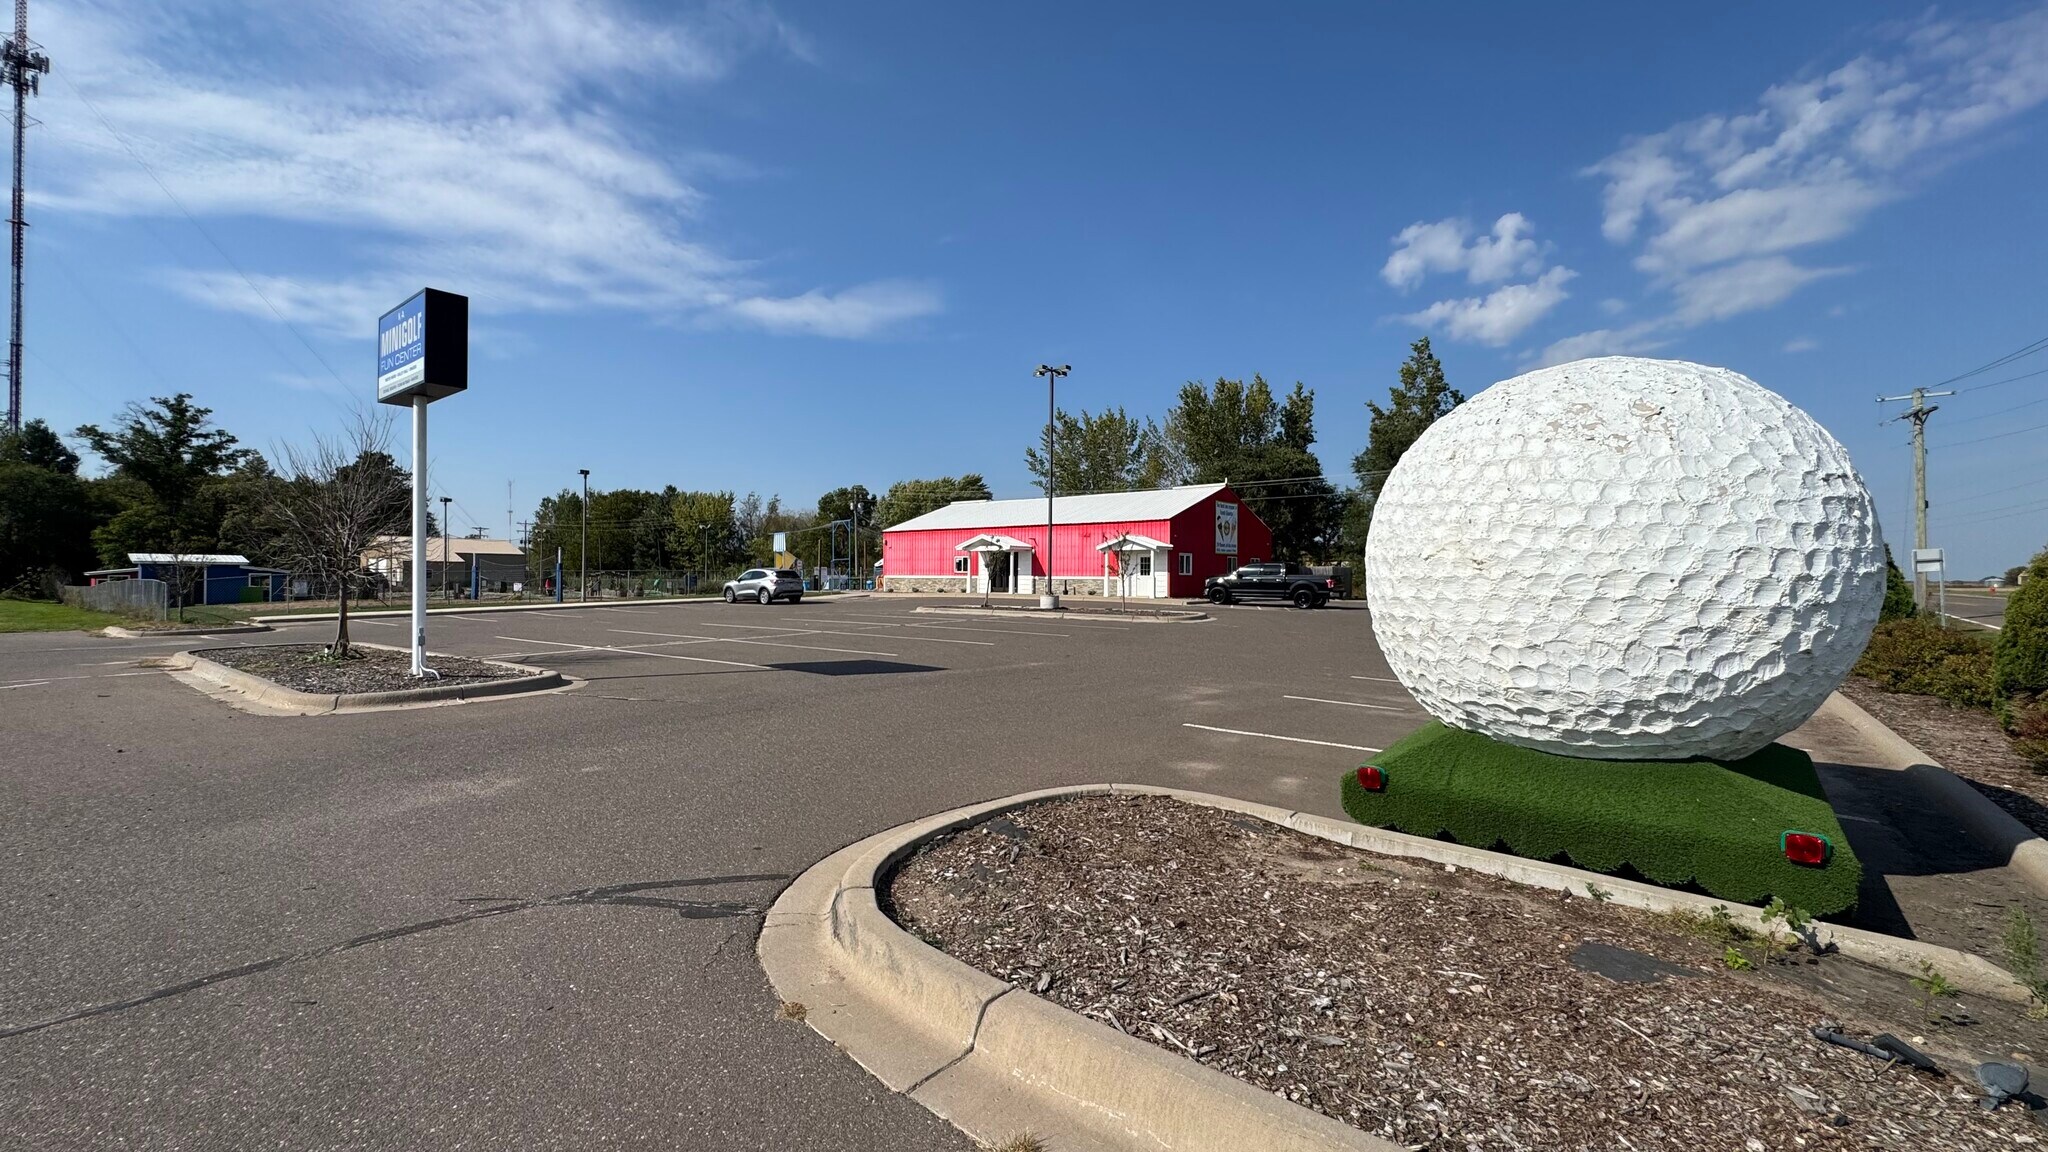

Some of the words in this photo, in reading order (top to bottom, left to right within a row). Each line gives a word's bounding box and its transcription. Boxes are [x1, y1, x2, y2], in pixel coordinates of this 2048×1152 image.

[382, 312, 422, 358] MINIGOLF
[381, 357, 394, 372] FUN
[395, 343, 422, 366] CENTER
